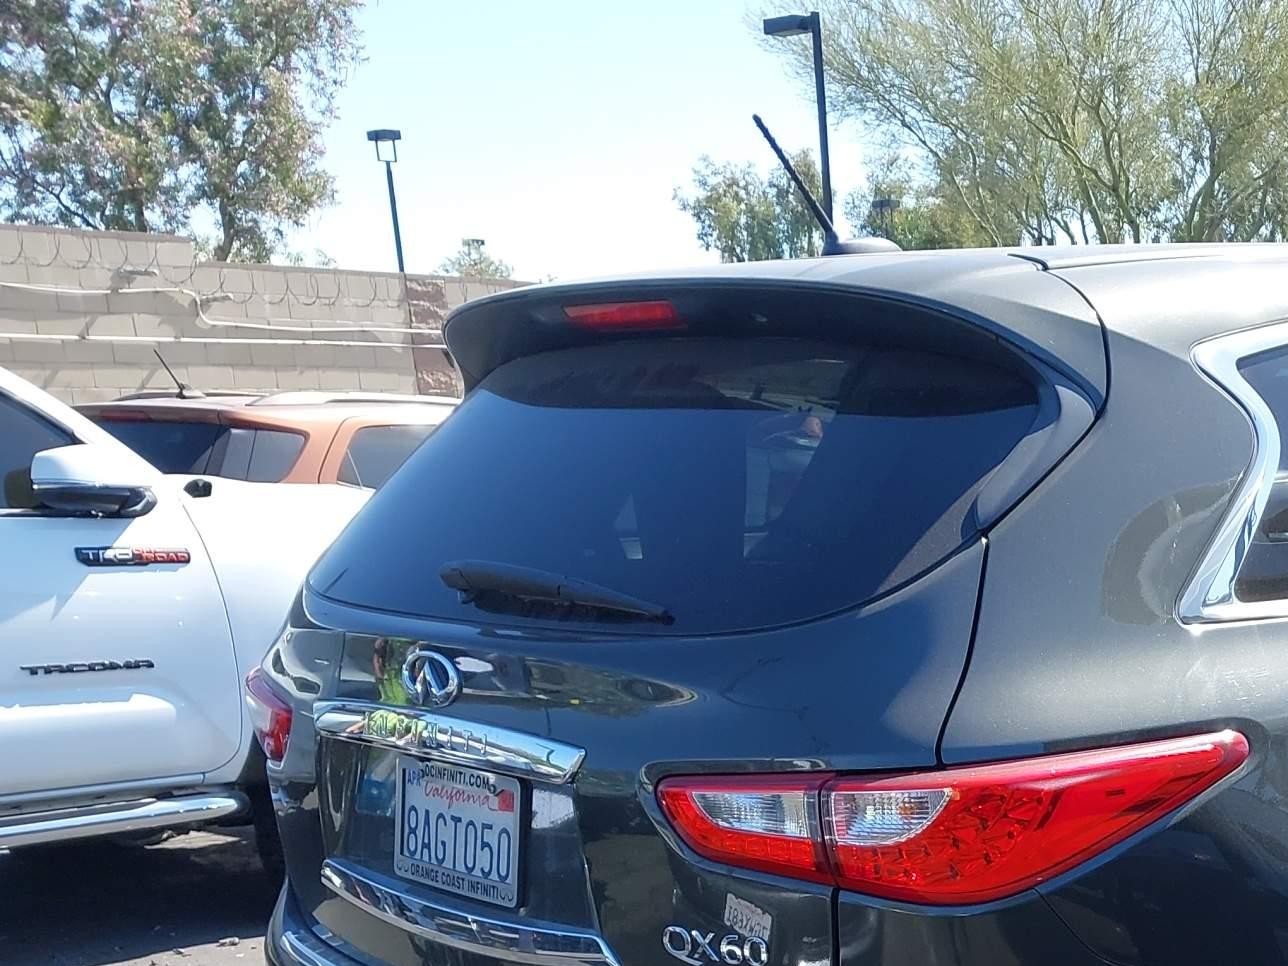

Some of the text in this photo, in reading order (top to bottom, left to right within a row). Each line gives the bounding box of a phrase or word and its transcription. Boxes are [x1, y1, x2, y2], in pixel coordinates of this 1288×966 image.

[142, 552, 189, 562] ROAD
[19, 658, 156, 676] TACOMA
[425, 763, 490, 790] OCINFINITI.COM
[424, 780, 498, 812] California
[406, 804, 512, 883] 8AGT050
[410, 862, 499, 901] ORANGE COAST INFINITI
[662, 925, 769, 966] QX60
